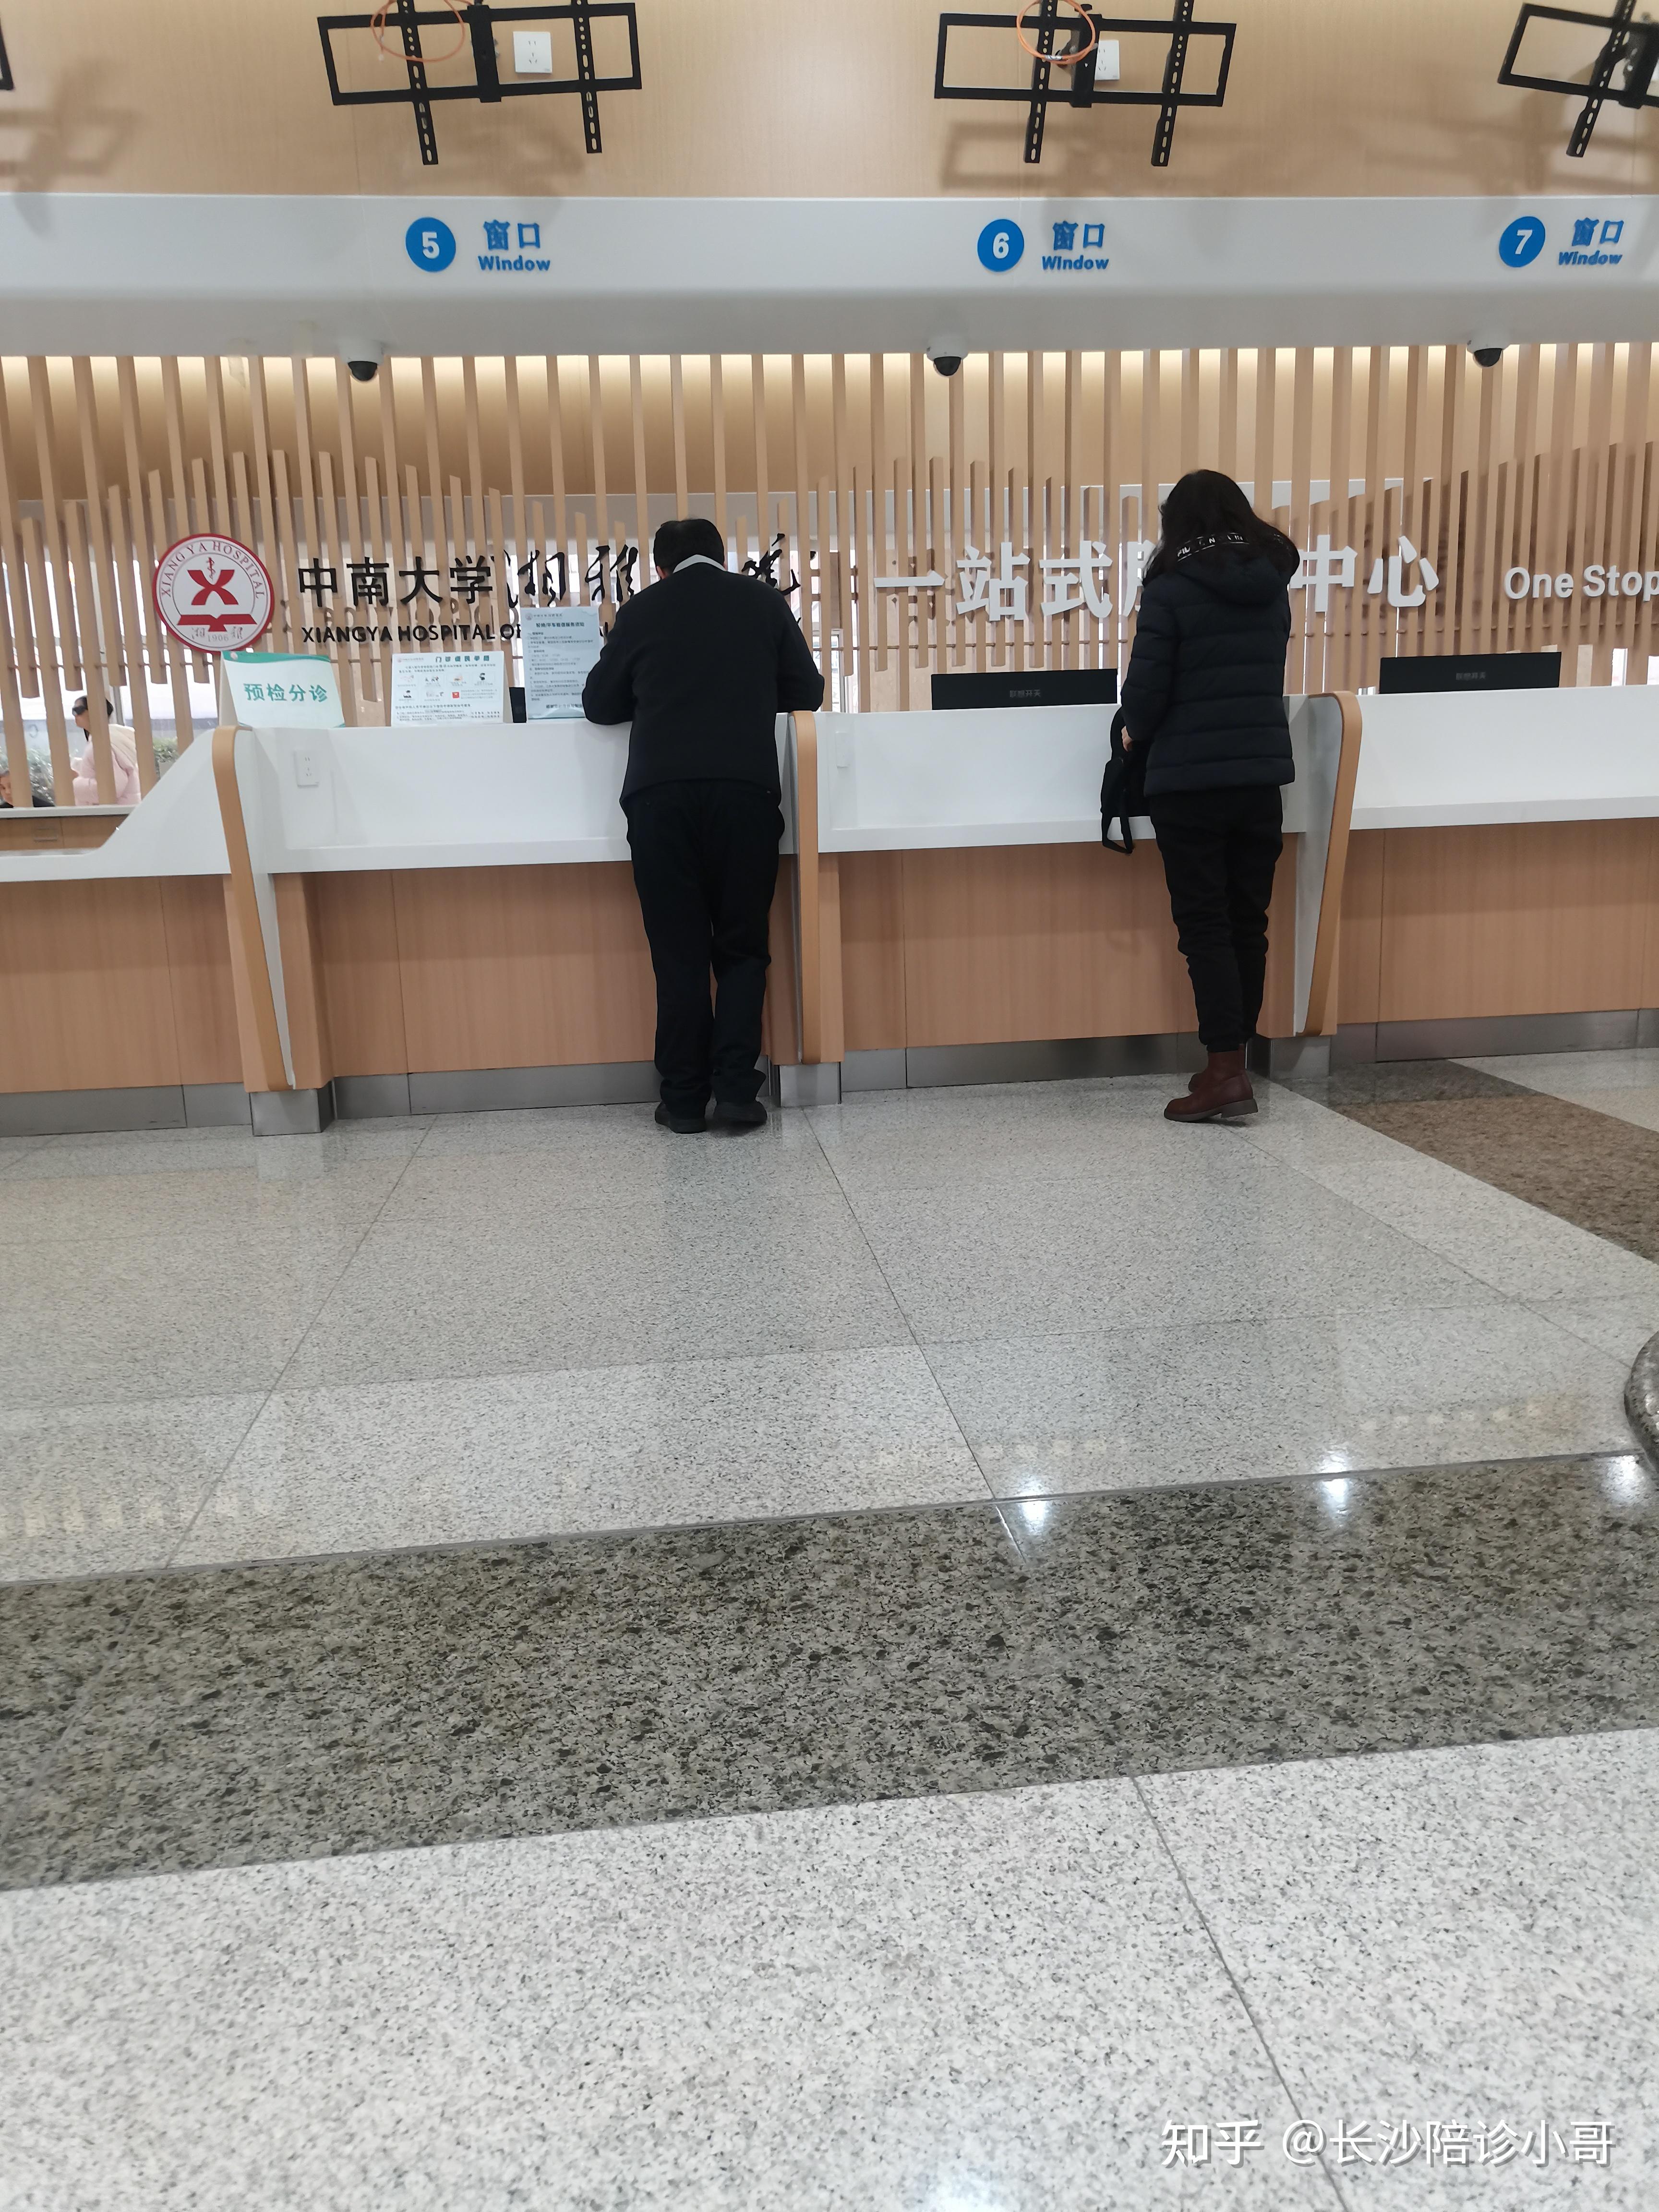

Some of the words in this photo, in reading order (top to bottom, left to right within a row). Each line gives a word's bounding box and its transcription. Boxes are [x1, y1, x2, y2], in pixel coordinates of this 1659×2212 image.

[422, 232, 440, 259] 5
[483, 219, 541, 251] 窗口
[993, 232, 1009, 259] 6
[1052, 220, 1105, 251] 窗口
[1515, 229, 1533, 255] 7
[1572, 217, 1624, 247] 窗口
[478, 255, 551, 271] Window
[1042, 255, 1109, 271] Window
[1558, 250, 1623, 265] Window
[211, 541, 264, 599] HOSPITAL
[298, 556, 493, 608] 中南大学
[1504, 566, 1574, 600] One
[1583, 565, 1659, 602] Stop
[208, 634, 229, 642] 1906
[301, 625, 393, 643] XIANGYA
[397, 625, 496, 642] HOSPITAL
[243, 683, 328, 702] 预检分诊
